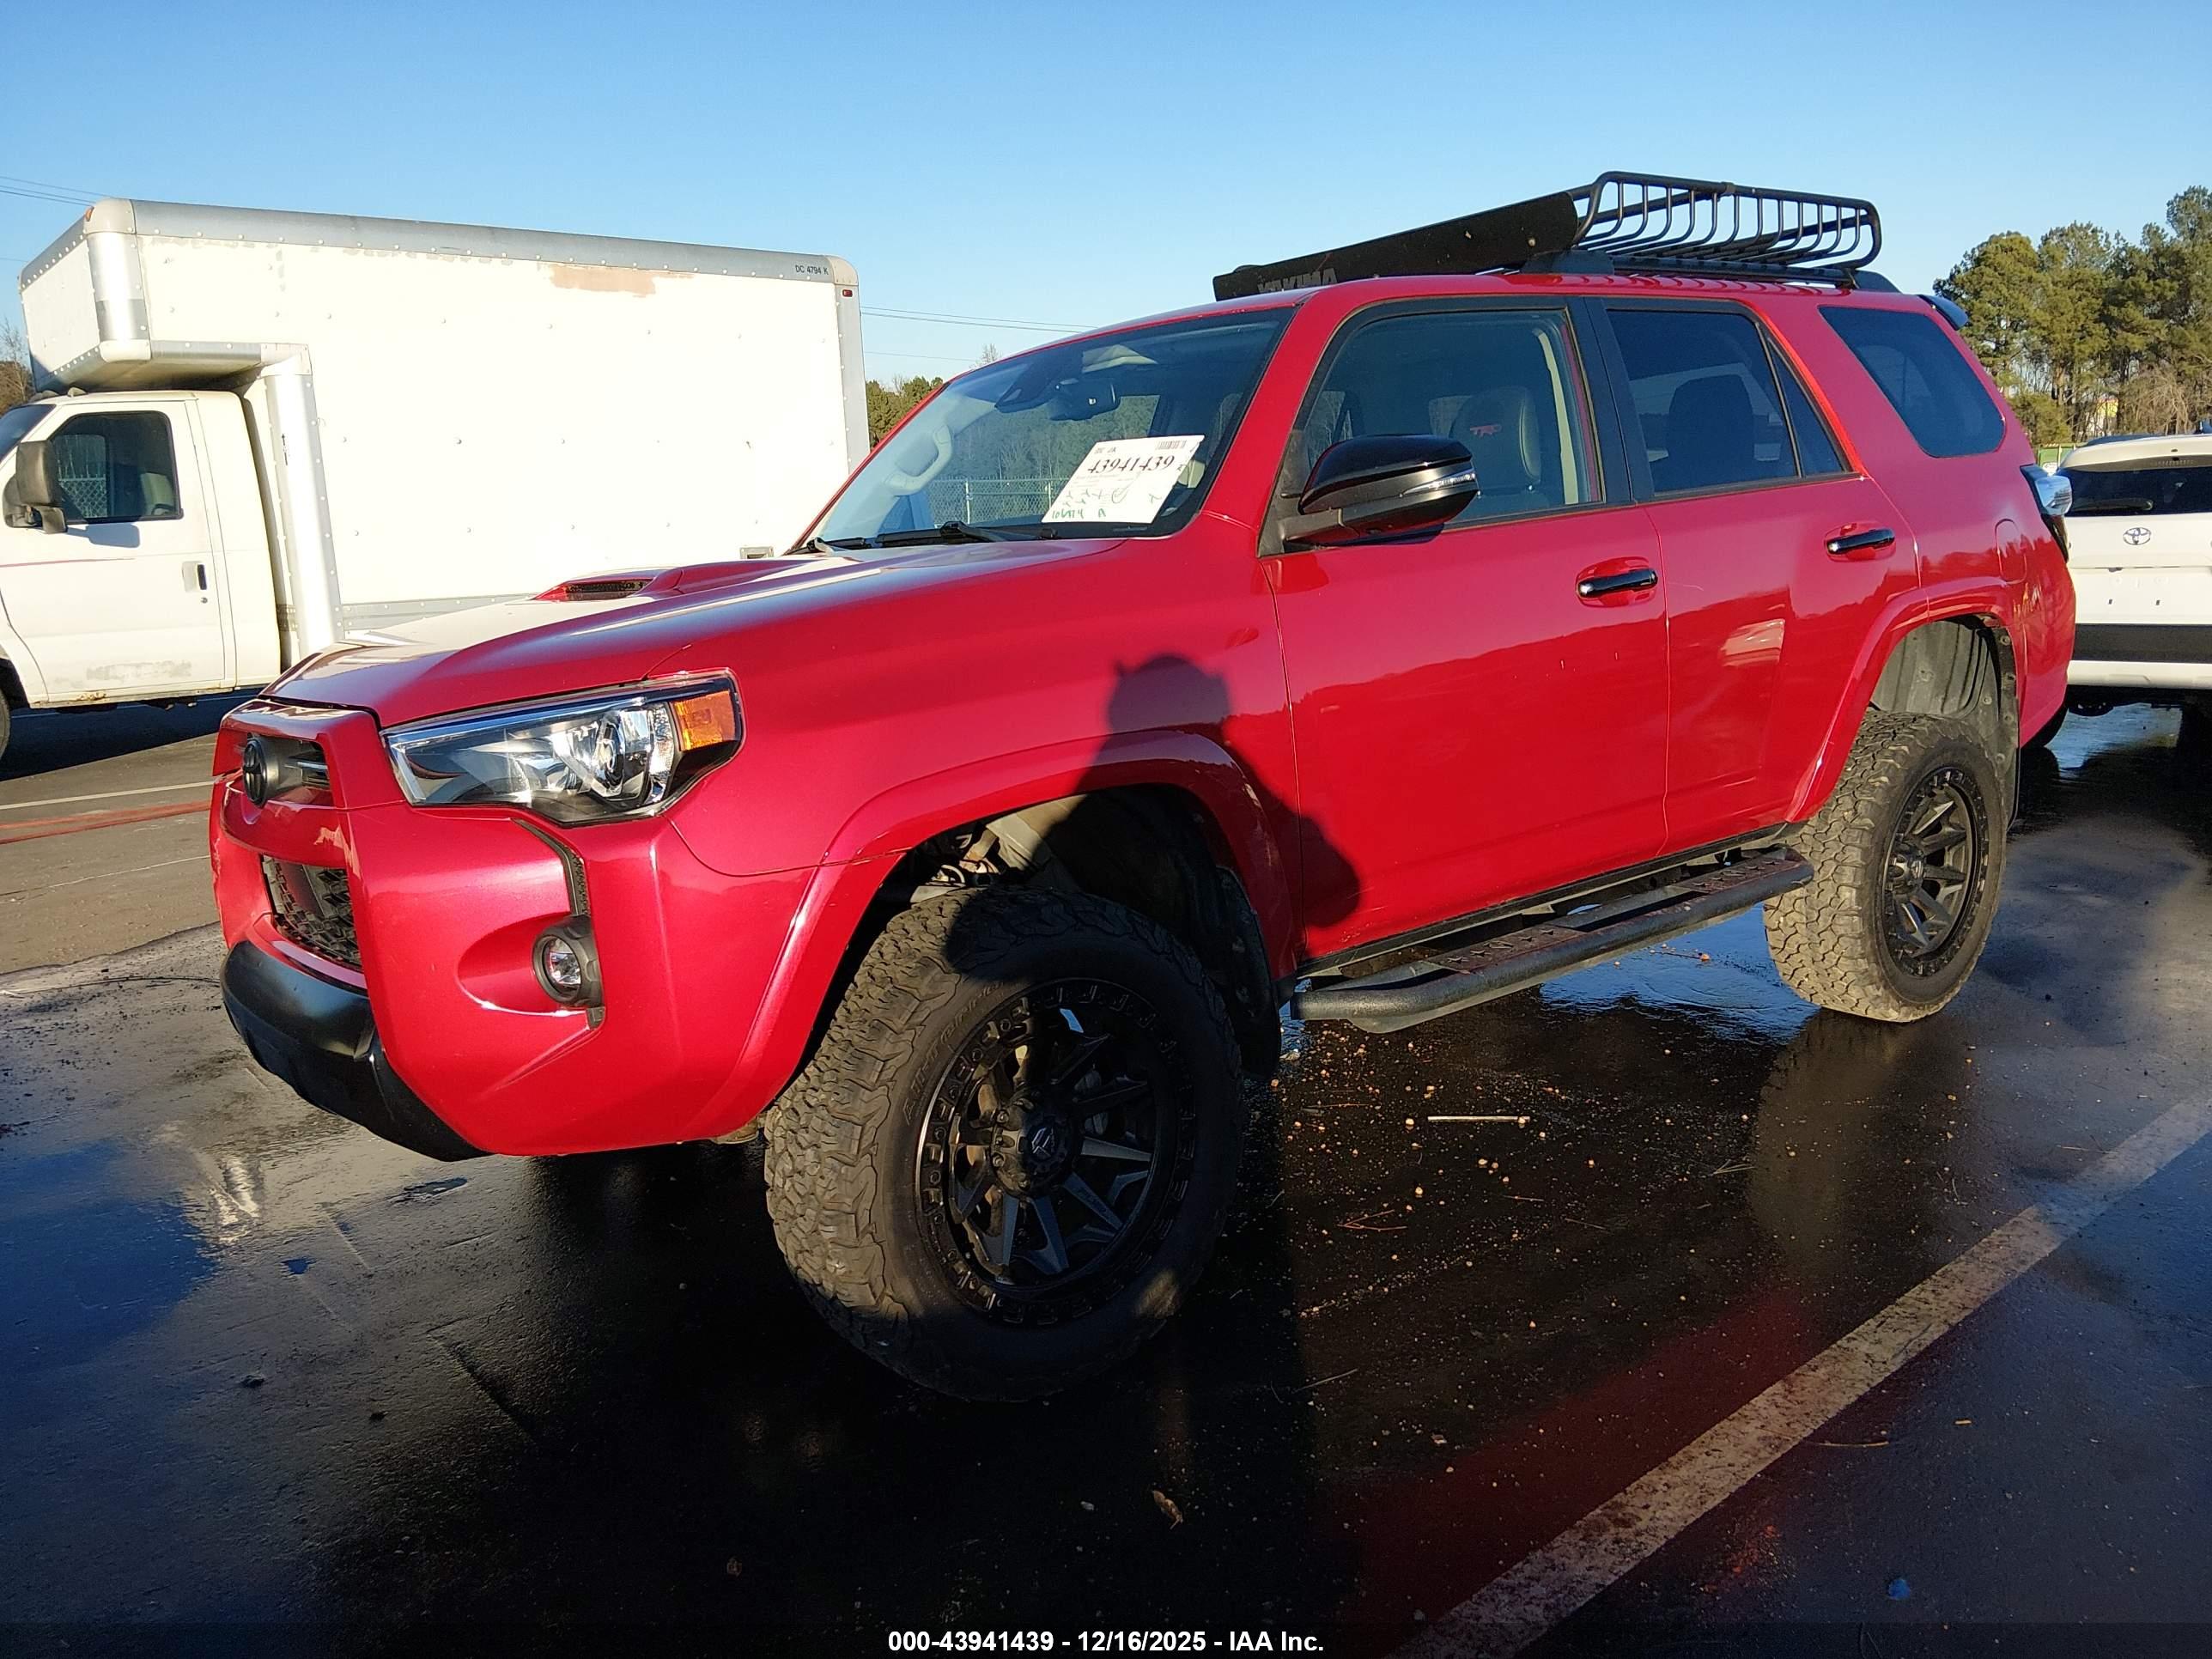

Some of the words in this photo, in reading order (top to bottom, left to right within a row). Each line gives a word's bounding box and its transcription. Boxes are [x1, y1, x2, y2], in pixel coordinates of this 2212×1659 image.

[795, 264, 805, 274] DC
[807, 265, 822, 275] 4794
[823, 267, 830, 276] K
[1087, 454, 1176, 474] 43941439
